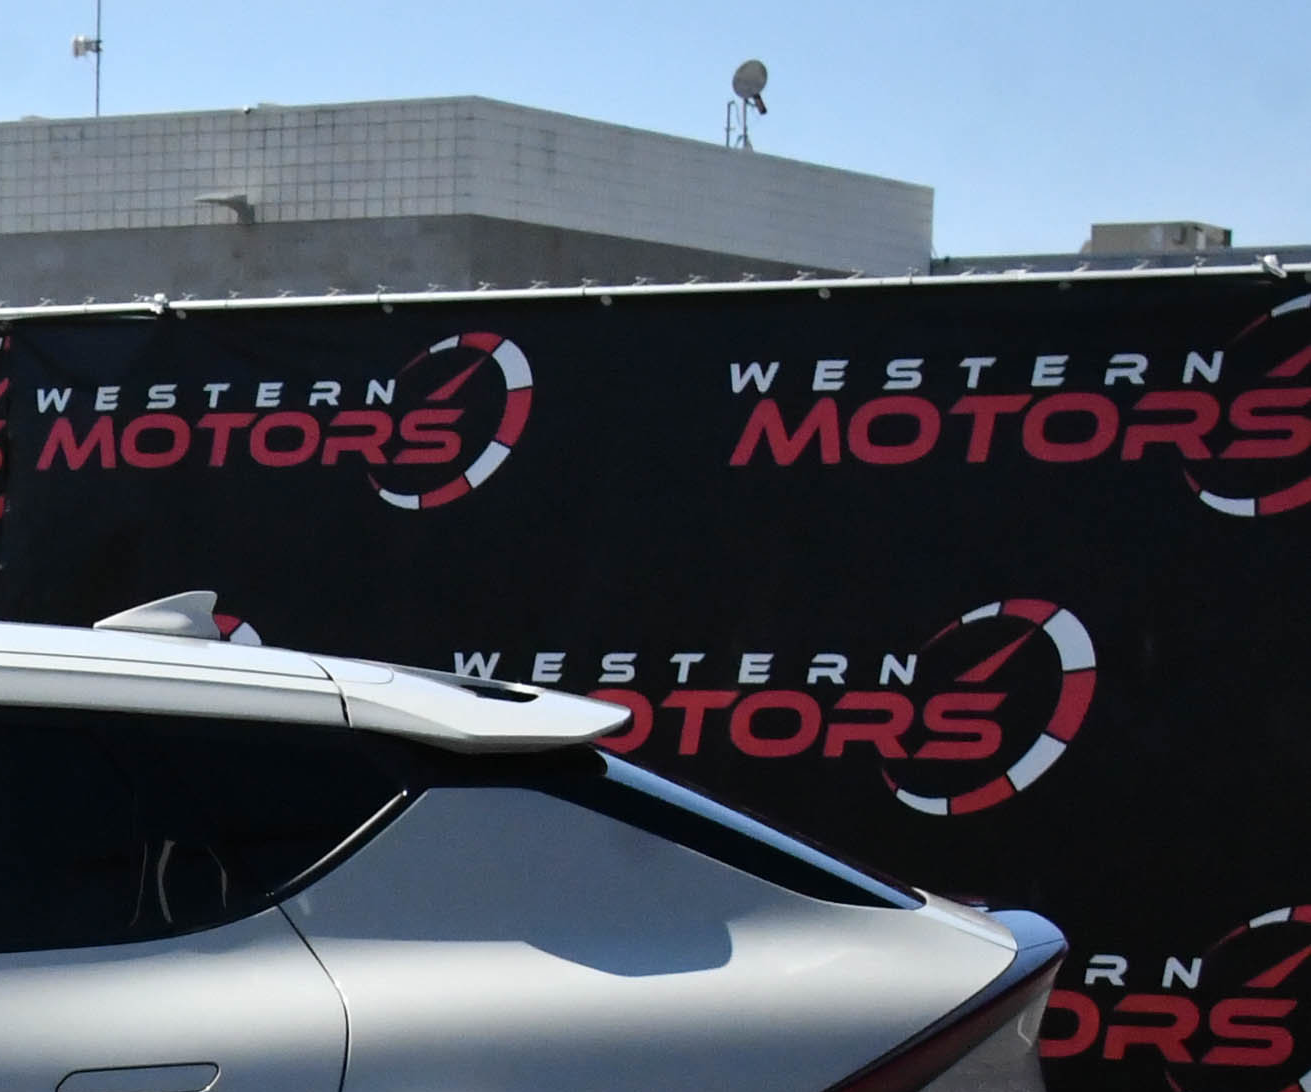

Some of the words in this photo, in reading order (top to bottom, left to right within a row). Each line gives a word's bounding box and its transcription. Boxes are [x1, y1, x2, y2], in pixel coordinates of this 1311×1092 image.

[38, 380, 395, 412] WESTERN
[731, 352, 1222, 393] WESTERN
[38, 409, 462, 470] MOTORS
[730, 388, 1311, 465] MOTORS
[454, 653, 917, 686] WESTERN
[589, 689, 1006, 759] OTORS
